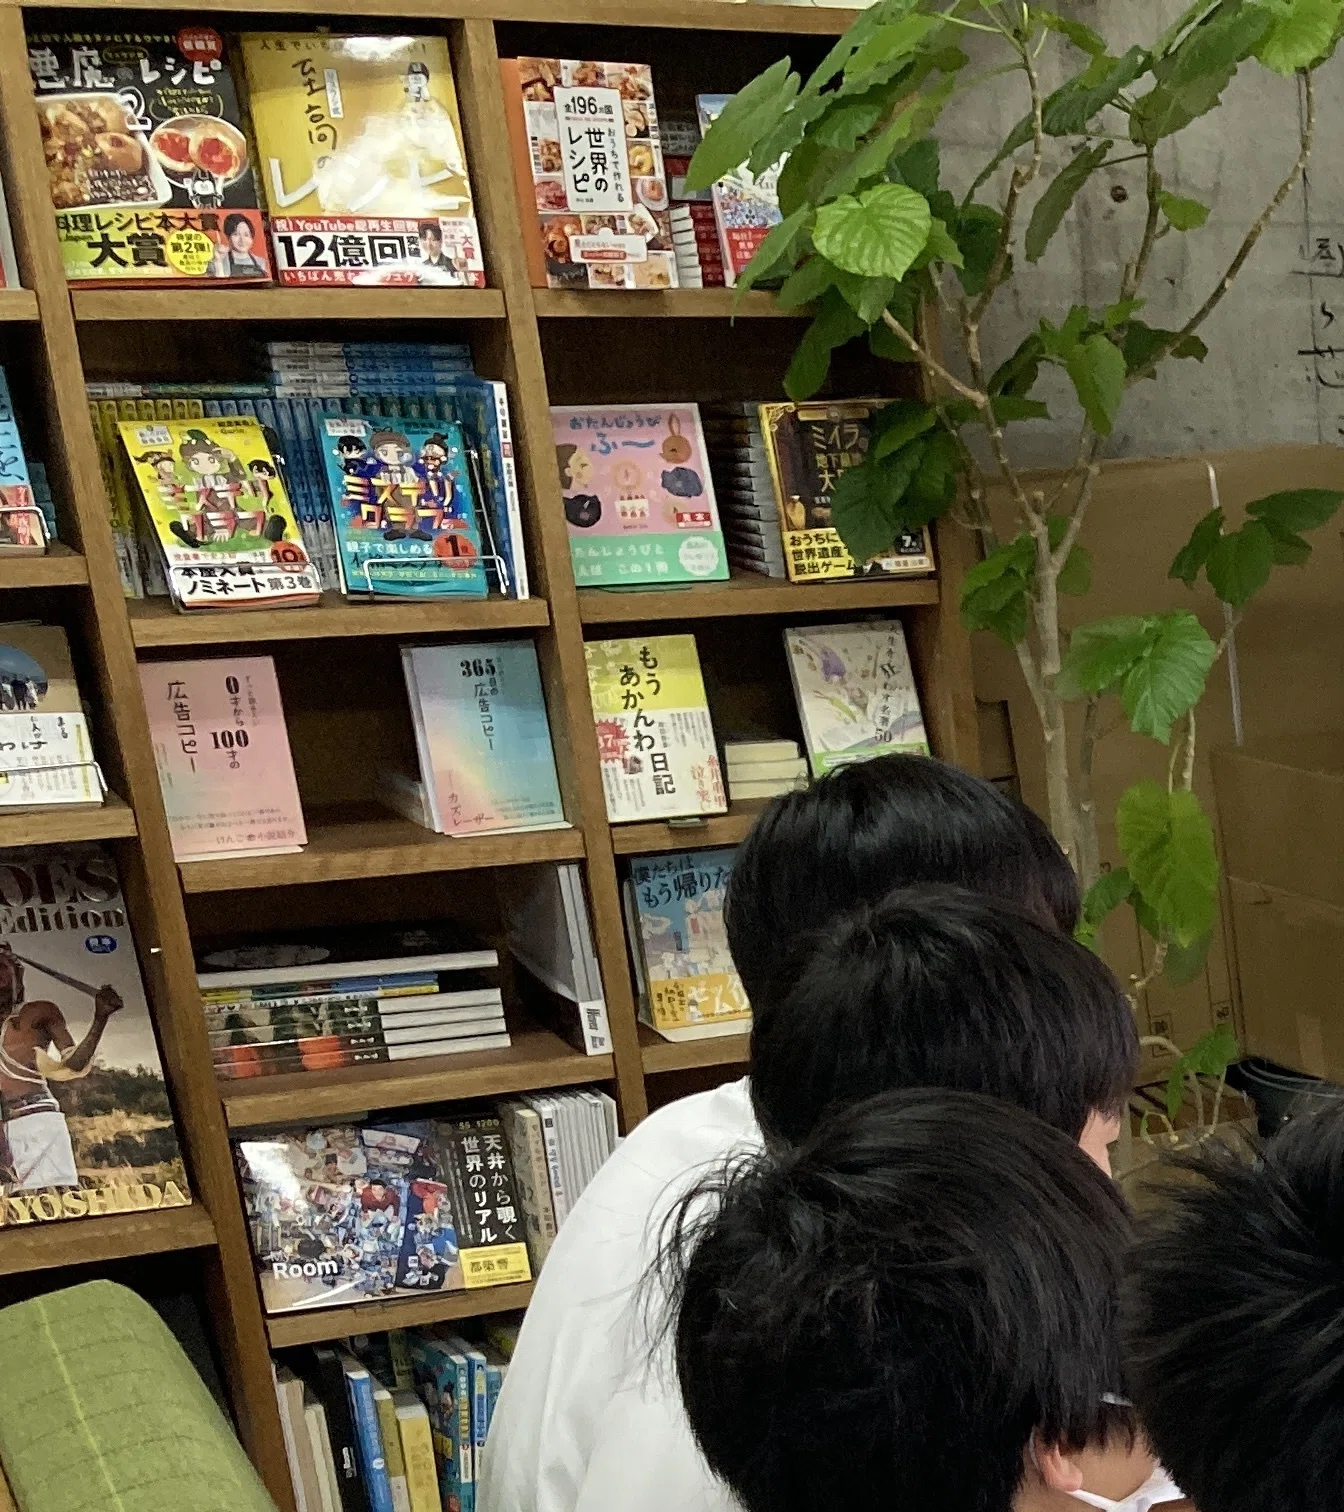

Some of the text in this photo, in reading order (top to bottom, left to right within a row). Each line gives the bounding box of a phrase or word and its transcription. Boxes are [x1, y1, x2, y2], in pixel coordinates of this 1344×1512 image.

[567, 126, 590, 193] レシピ
[585, 127, 608, 193] 世界の
[87, 232, 168, 267] 大賞
[278, 233, 406, 268] 12億回
[570, 414, 662, 430] おたんじょうび
[811, 424, 859, 450] ミイラ
[792, 547, 847, 561] 世界遺産
[189, 576, 312, 595] ノミネート 第3巻
[639, 646, 662, 696] もう
[167, 680, 198, 773] 広告コピー
[474, 682, 495, 751] 広告コピー
[619, 665, 655, 752] あかんわ
[651, 752, 676, 796] 日記
[6, 1180, 188, 1222] YOSHIDA
[461, 1136, 498, 1244] 世界のリアル
[481, 1134, 518, 1241] 天井から覗く
[272, 1259, 339, 1280] Room
